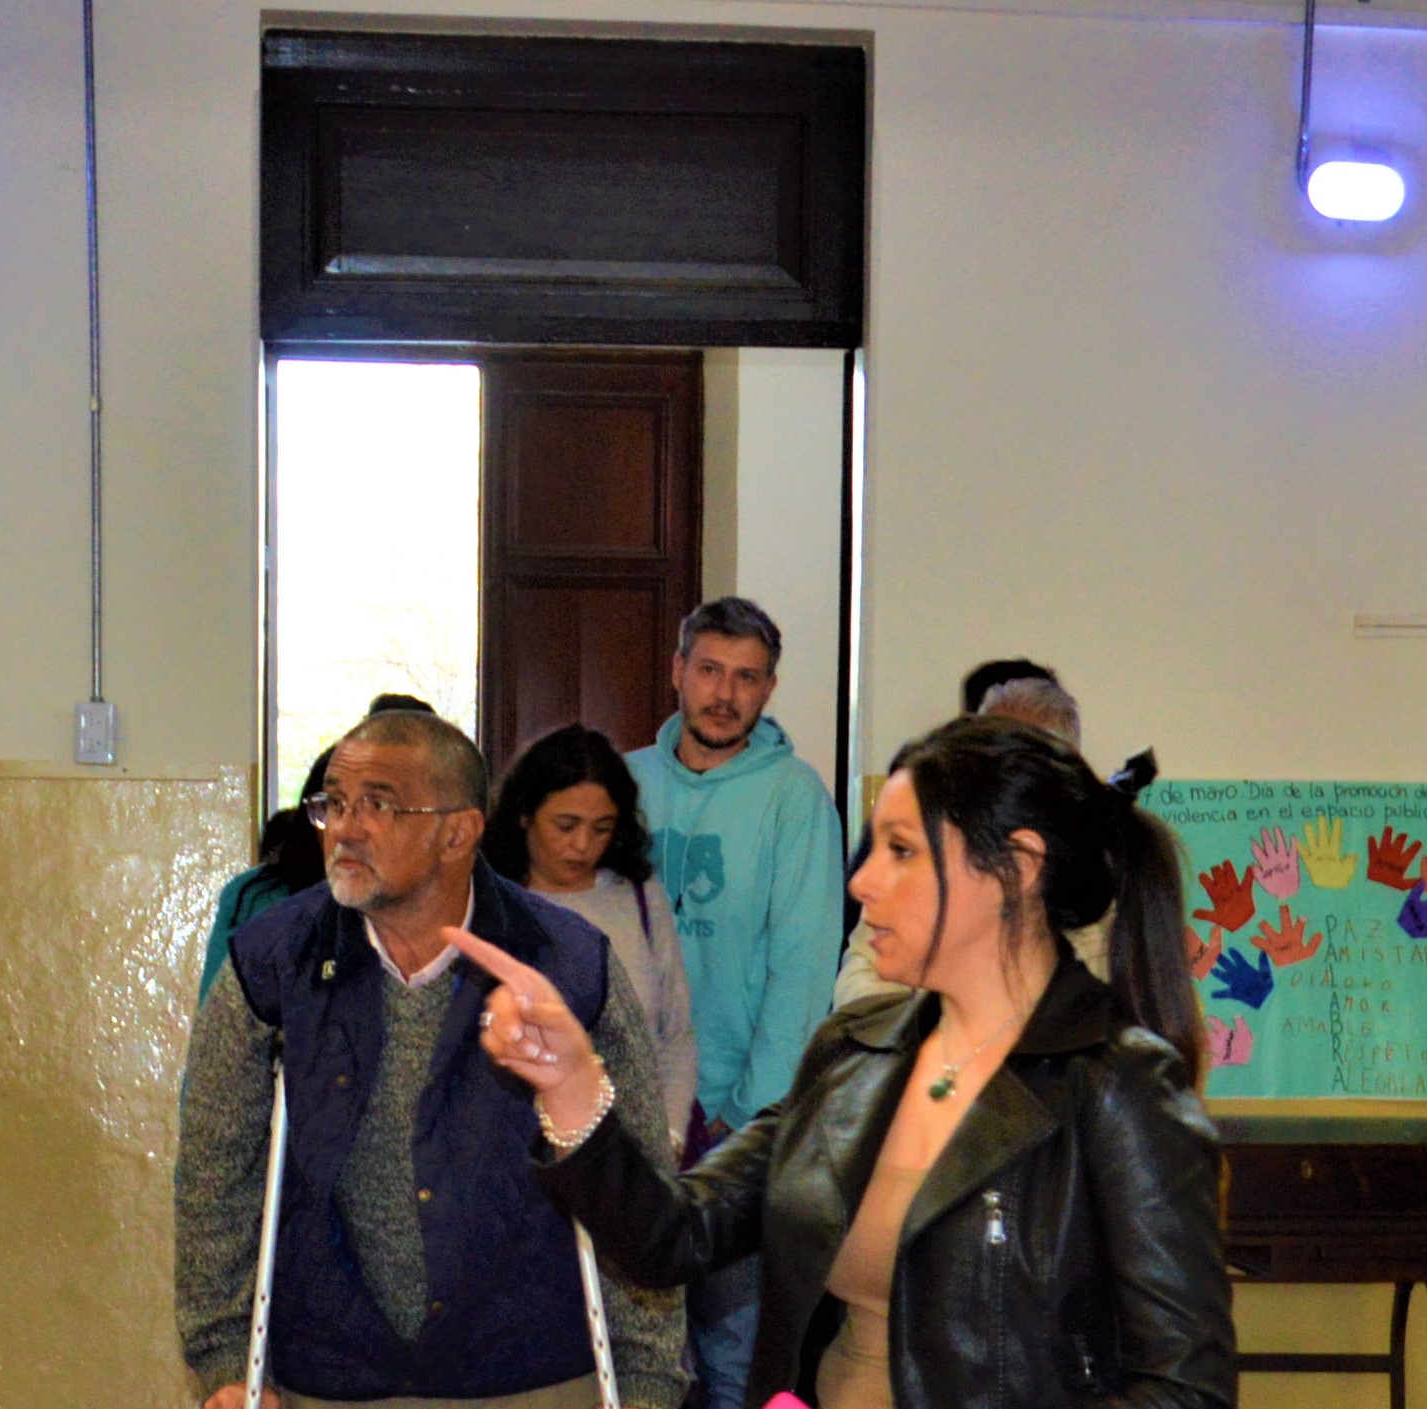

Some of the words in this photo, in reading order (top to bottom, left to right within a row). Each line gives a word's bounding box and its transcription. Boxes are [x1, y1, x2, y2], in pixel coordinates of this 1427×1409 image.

[1160, 782, 1184, 805] de
[1190, 785, 1238, 804] mayo
[1283, 782, 1302, 799] de
[1309, 782, 1325, 799] la
[1162, 807, 1238, 824] violencia
[1245, 806, 1271, 821] en
[1277, 803, 1293, 819] el
[1300, 803, 1375, 826] espacio
[1325, 914, 1383, 943] PAZ
